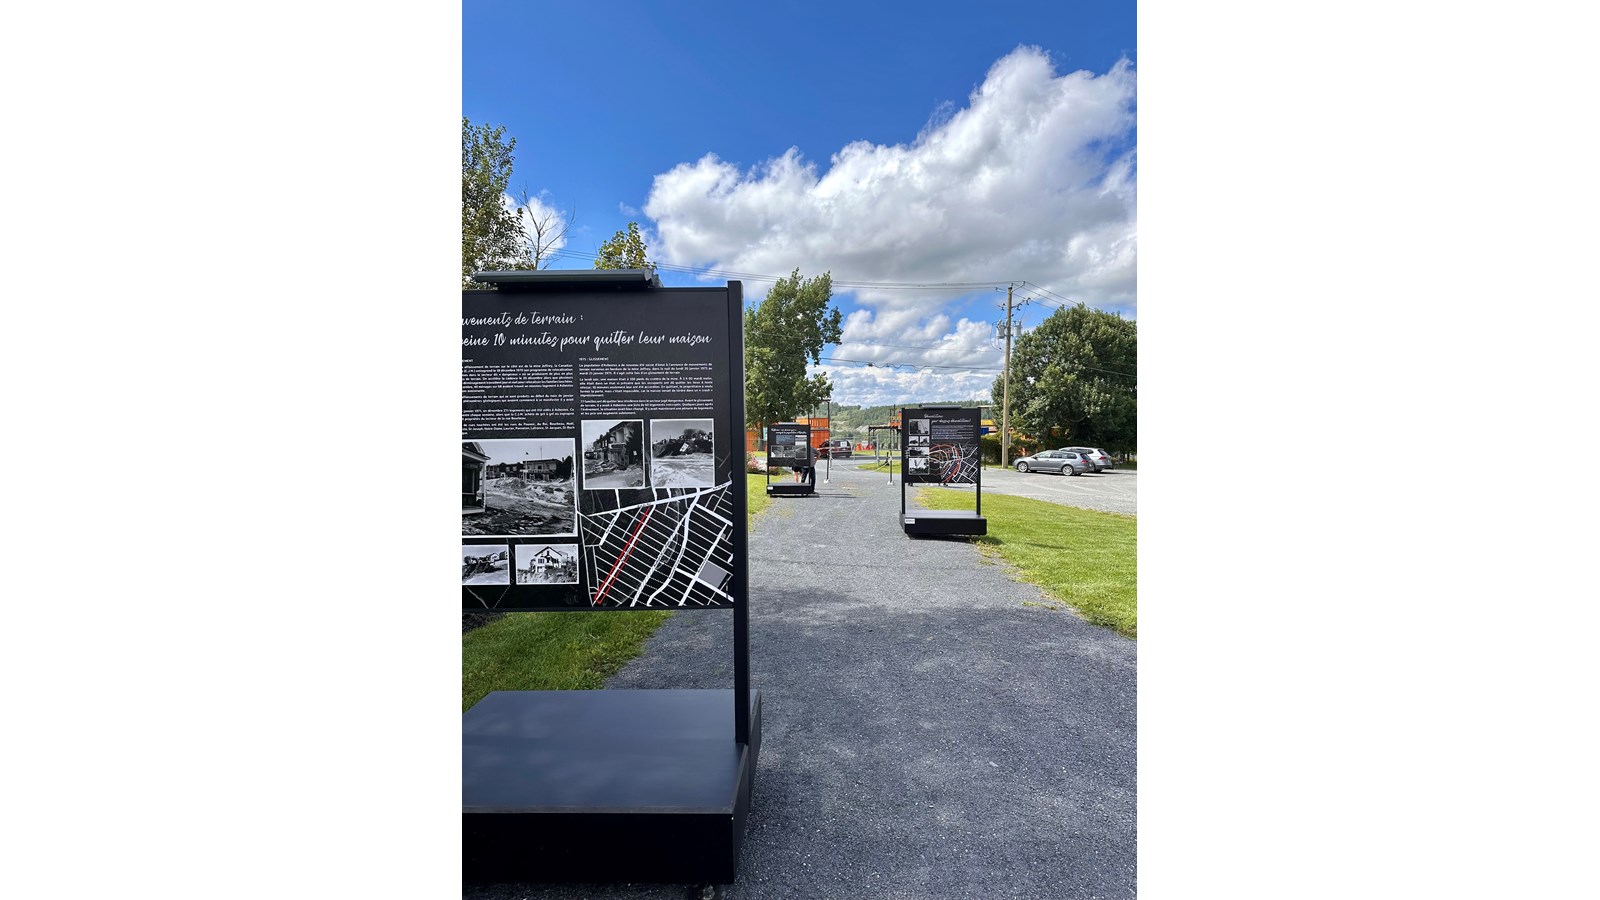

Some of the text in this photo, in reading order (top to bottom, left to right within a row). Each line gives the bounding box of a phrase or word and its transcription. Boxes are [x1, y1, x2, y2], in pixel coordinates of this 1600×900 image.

[515, 311, 529, 325] de
[530, 311, 577, 325] terrain
[462, 330, 713, 352] eine 10 minutes pour quitter leur maison
